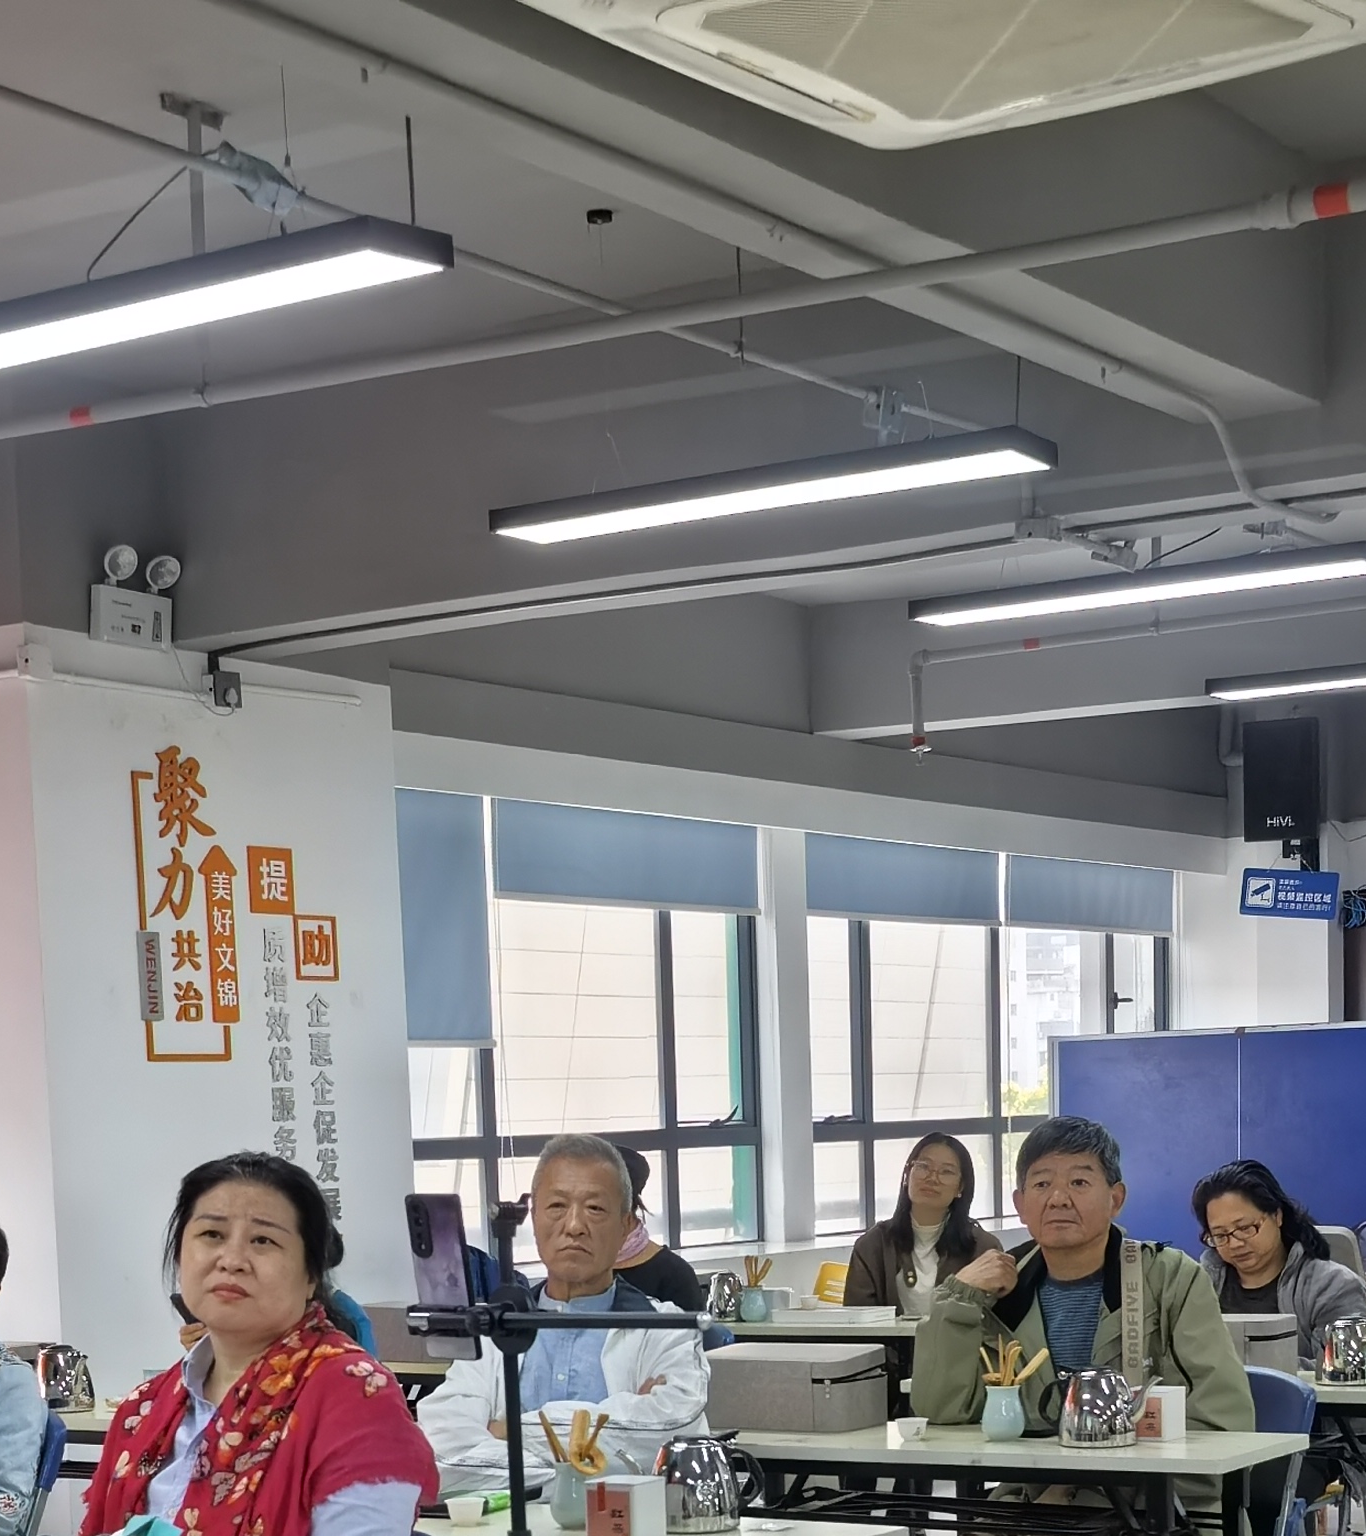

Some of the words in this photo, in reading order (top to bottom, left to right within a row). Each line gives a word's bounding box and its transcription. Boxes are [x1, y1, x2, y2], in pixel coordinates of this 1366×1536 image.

[144, 938, 160, 1015] WENJIN
[210, 870, 238, 1008] 美好文锦
